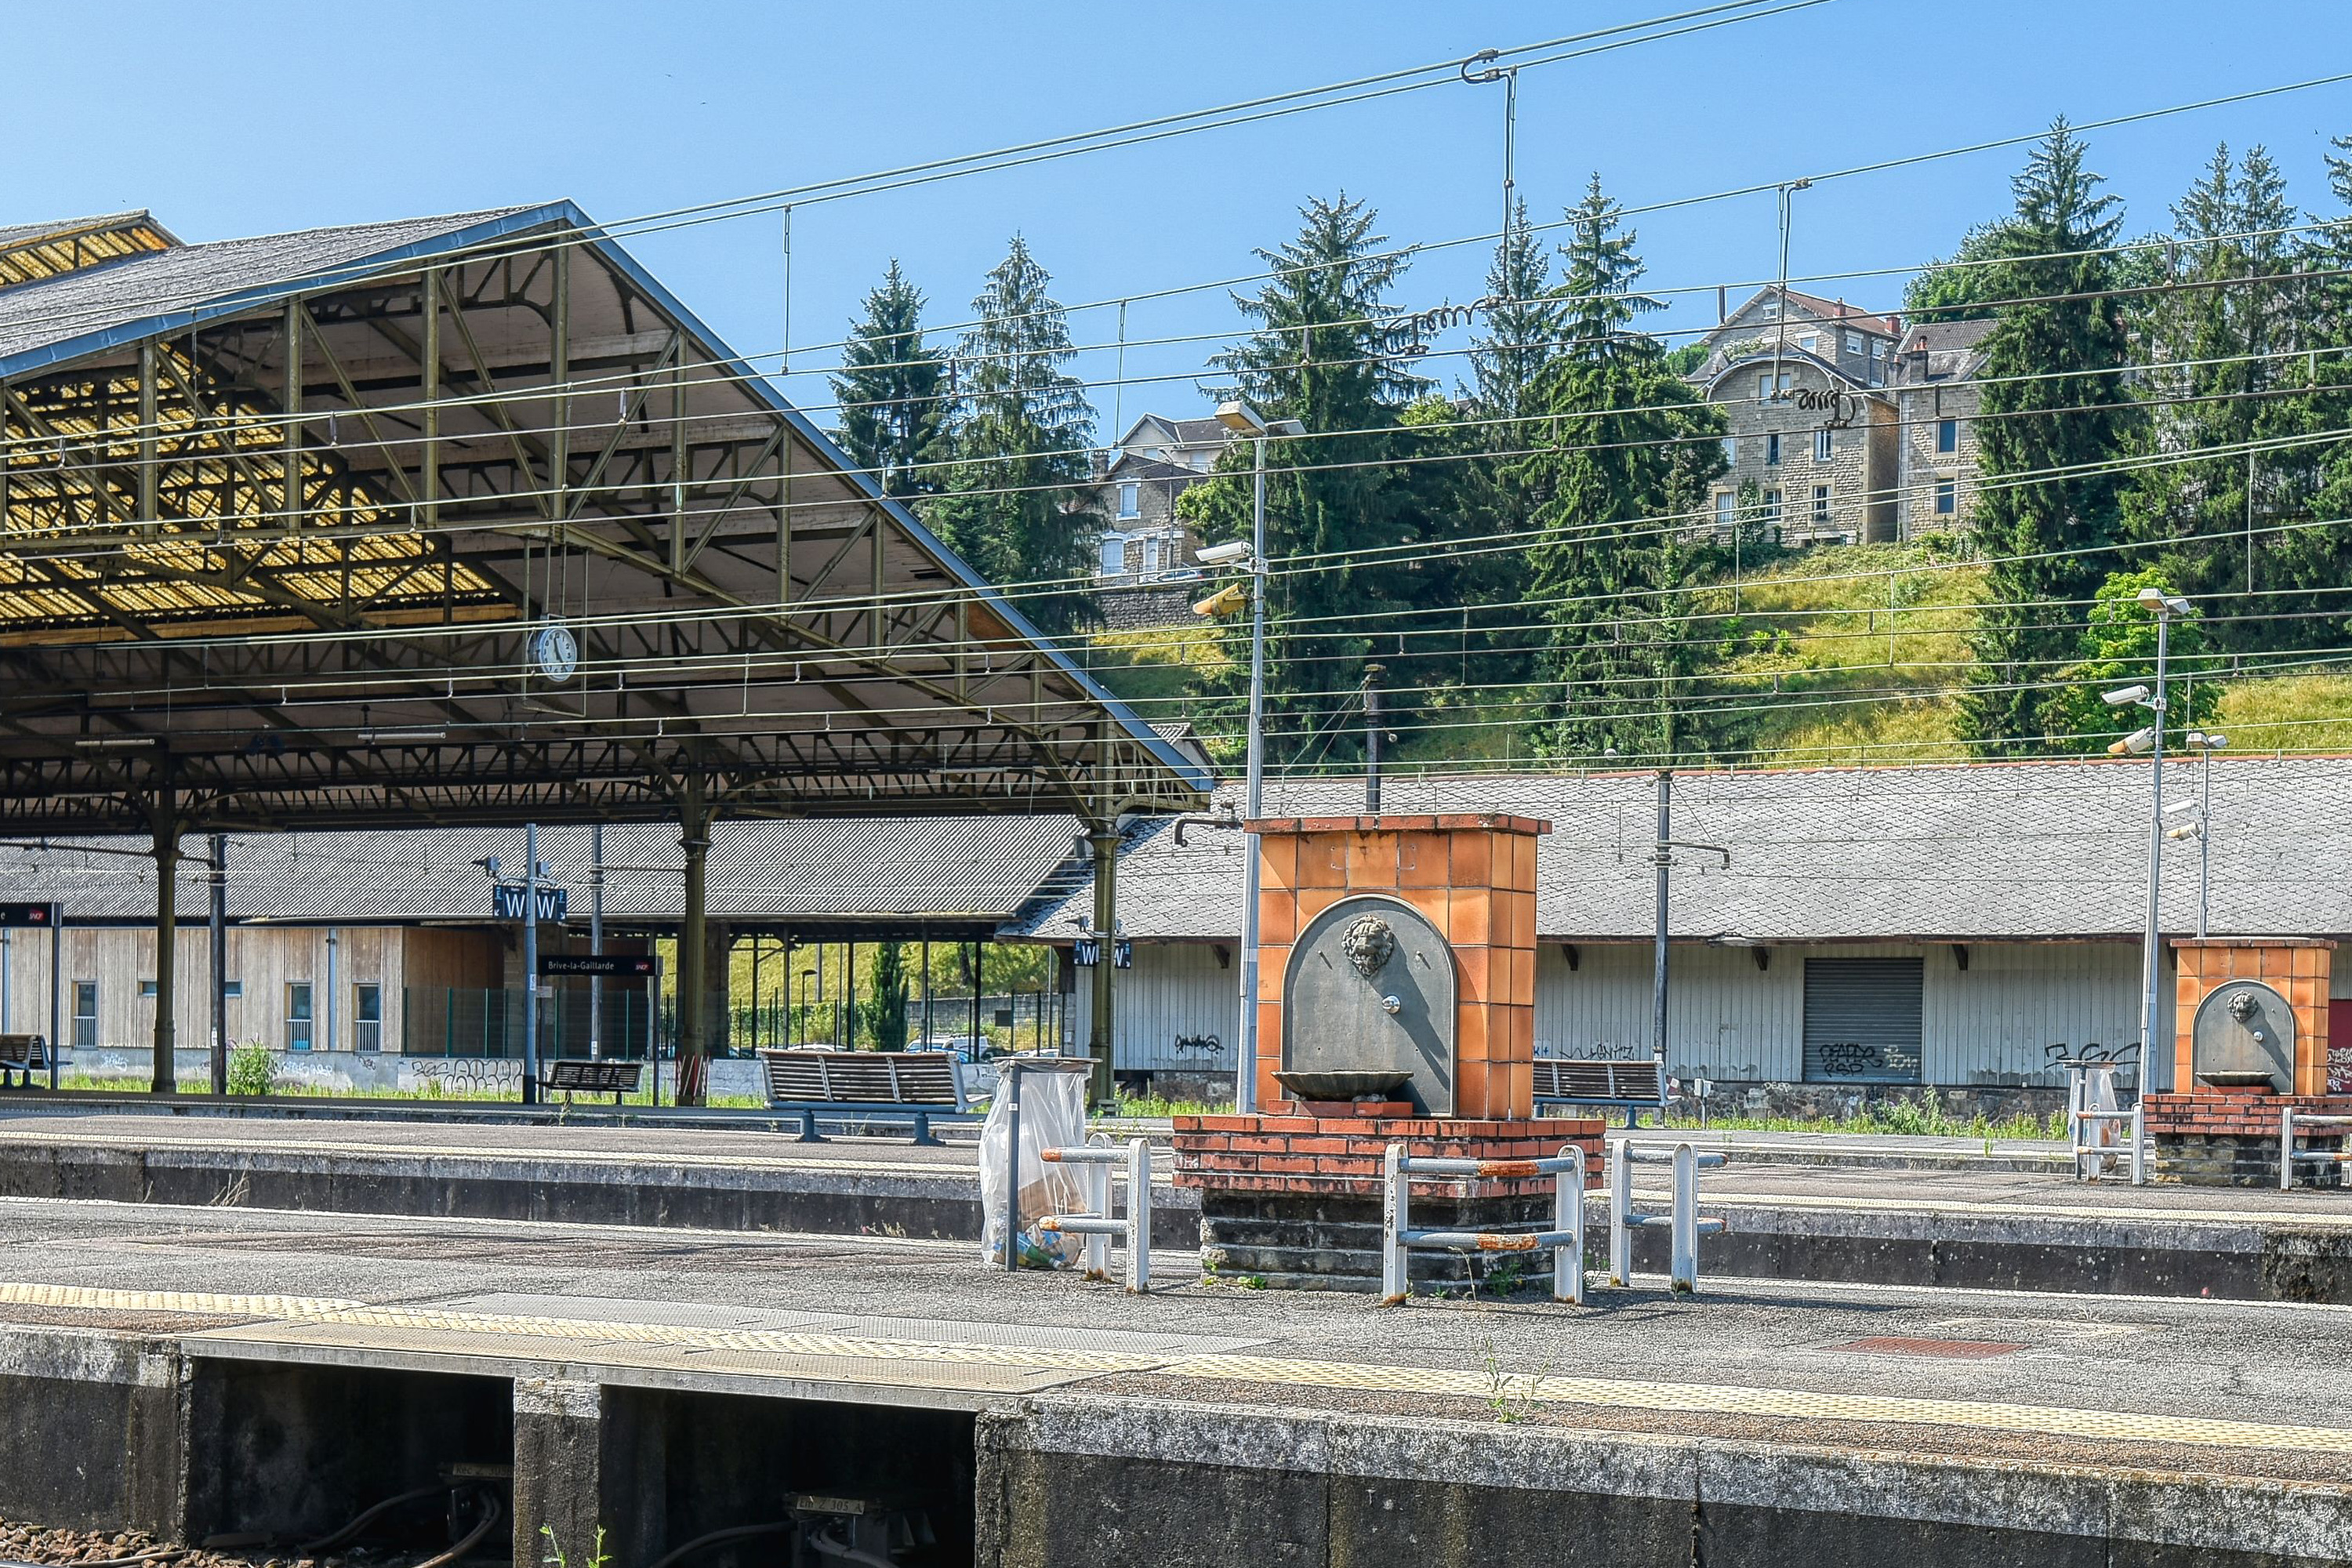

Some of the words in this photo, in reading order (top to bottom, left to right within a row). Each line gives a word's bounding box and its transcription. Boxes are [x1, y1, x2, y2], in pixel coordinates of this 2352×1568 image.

[505, 893, 525, 917] W
[536, 895, 556, 919] W
[548, 960, 615, 971] Brive-la-Gaillarde
[1082, 946, 1095, 965] W
